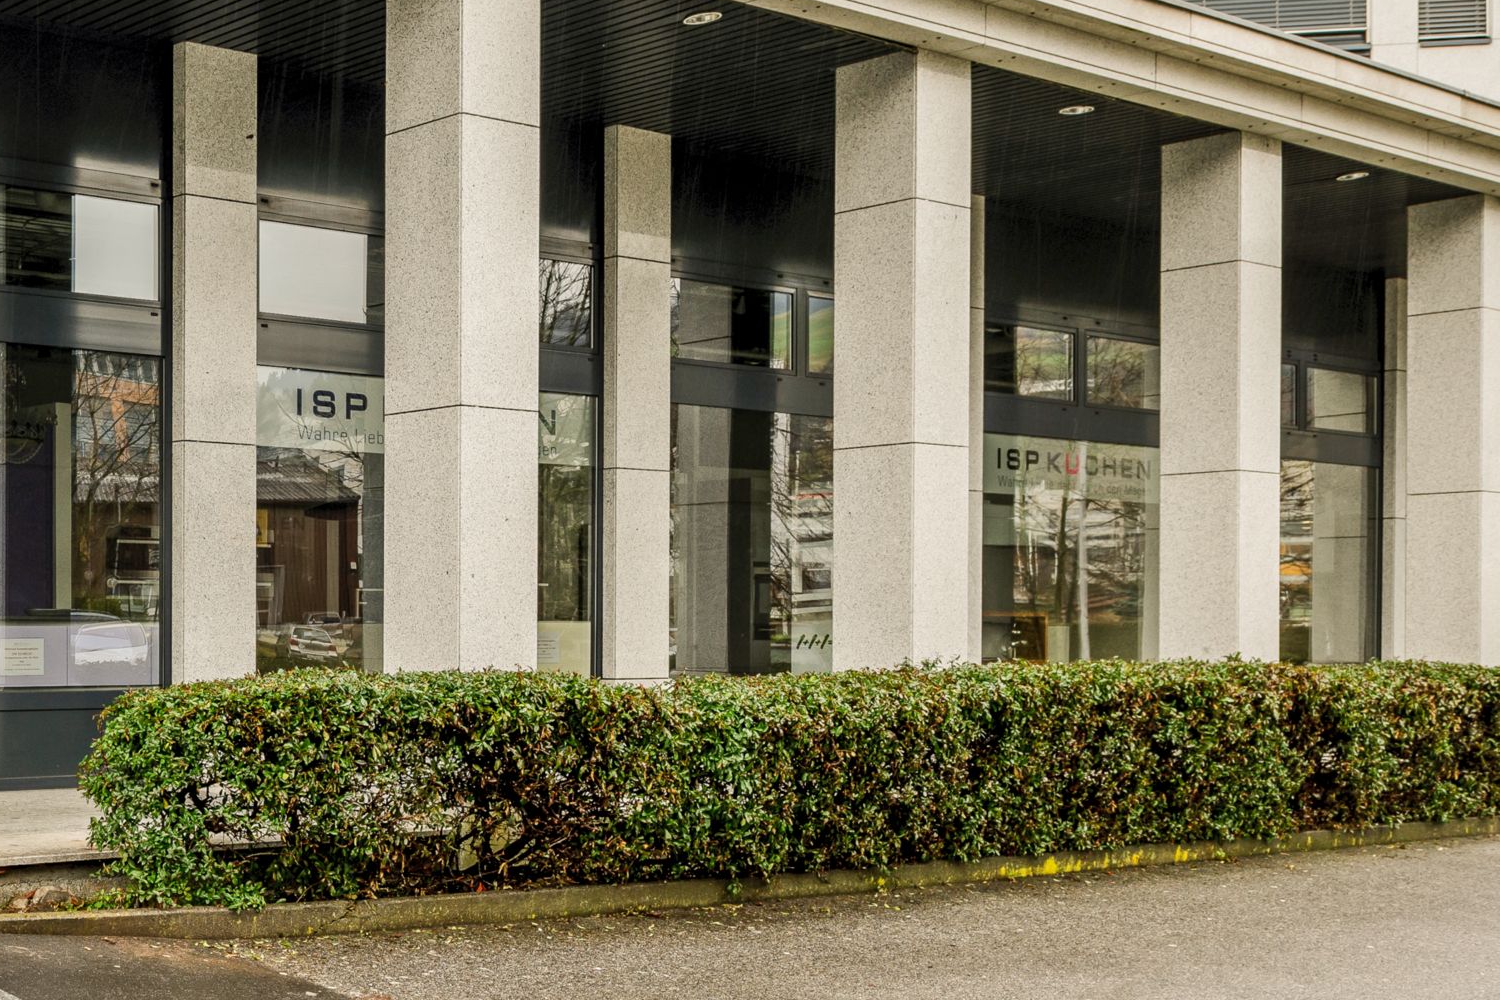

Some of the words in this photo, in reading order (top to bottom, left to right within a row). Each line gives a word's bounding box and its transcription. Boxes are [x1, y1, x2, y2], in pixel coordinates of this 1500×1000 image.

[296, 388, 368, 420] ISP
[355, 428, 385, 445] Lieb
[997, 447, 1040, 472] ISP
